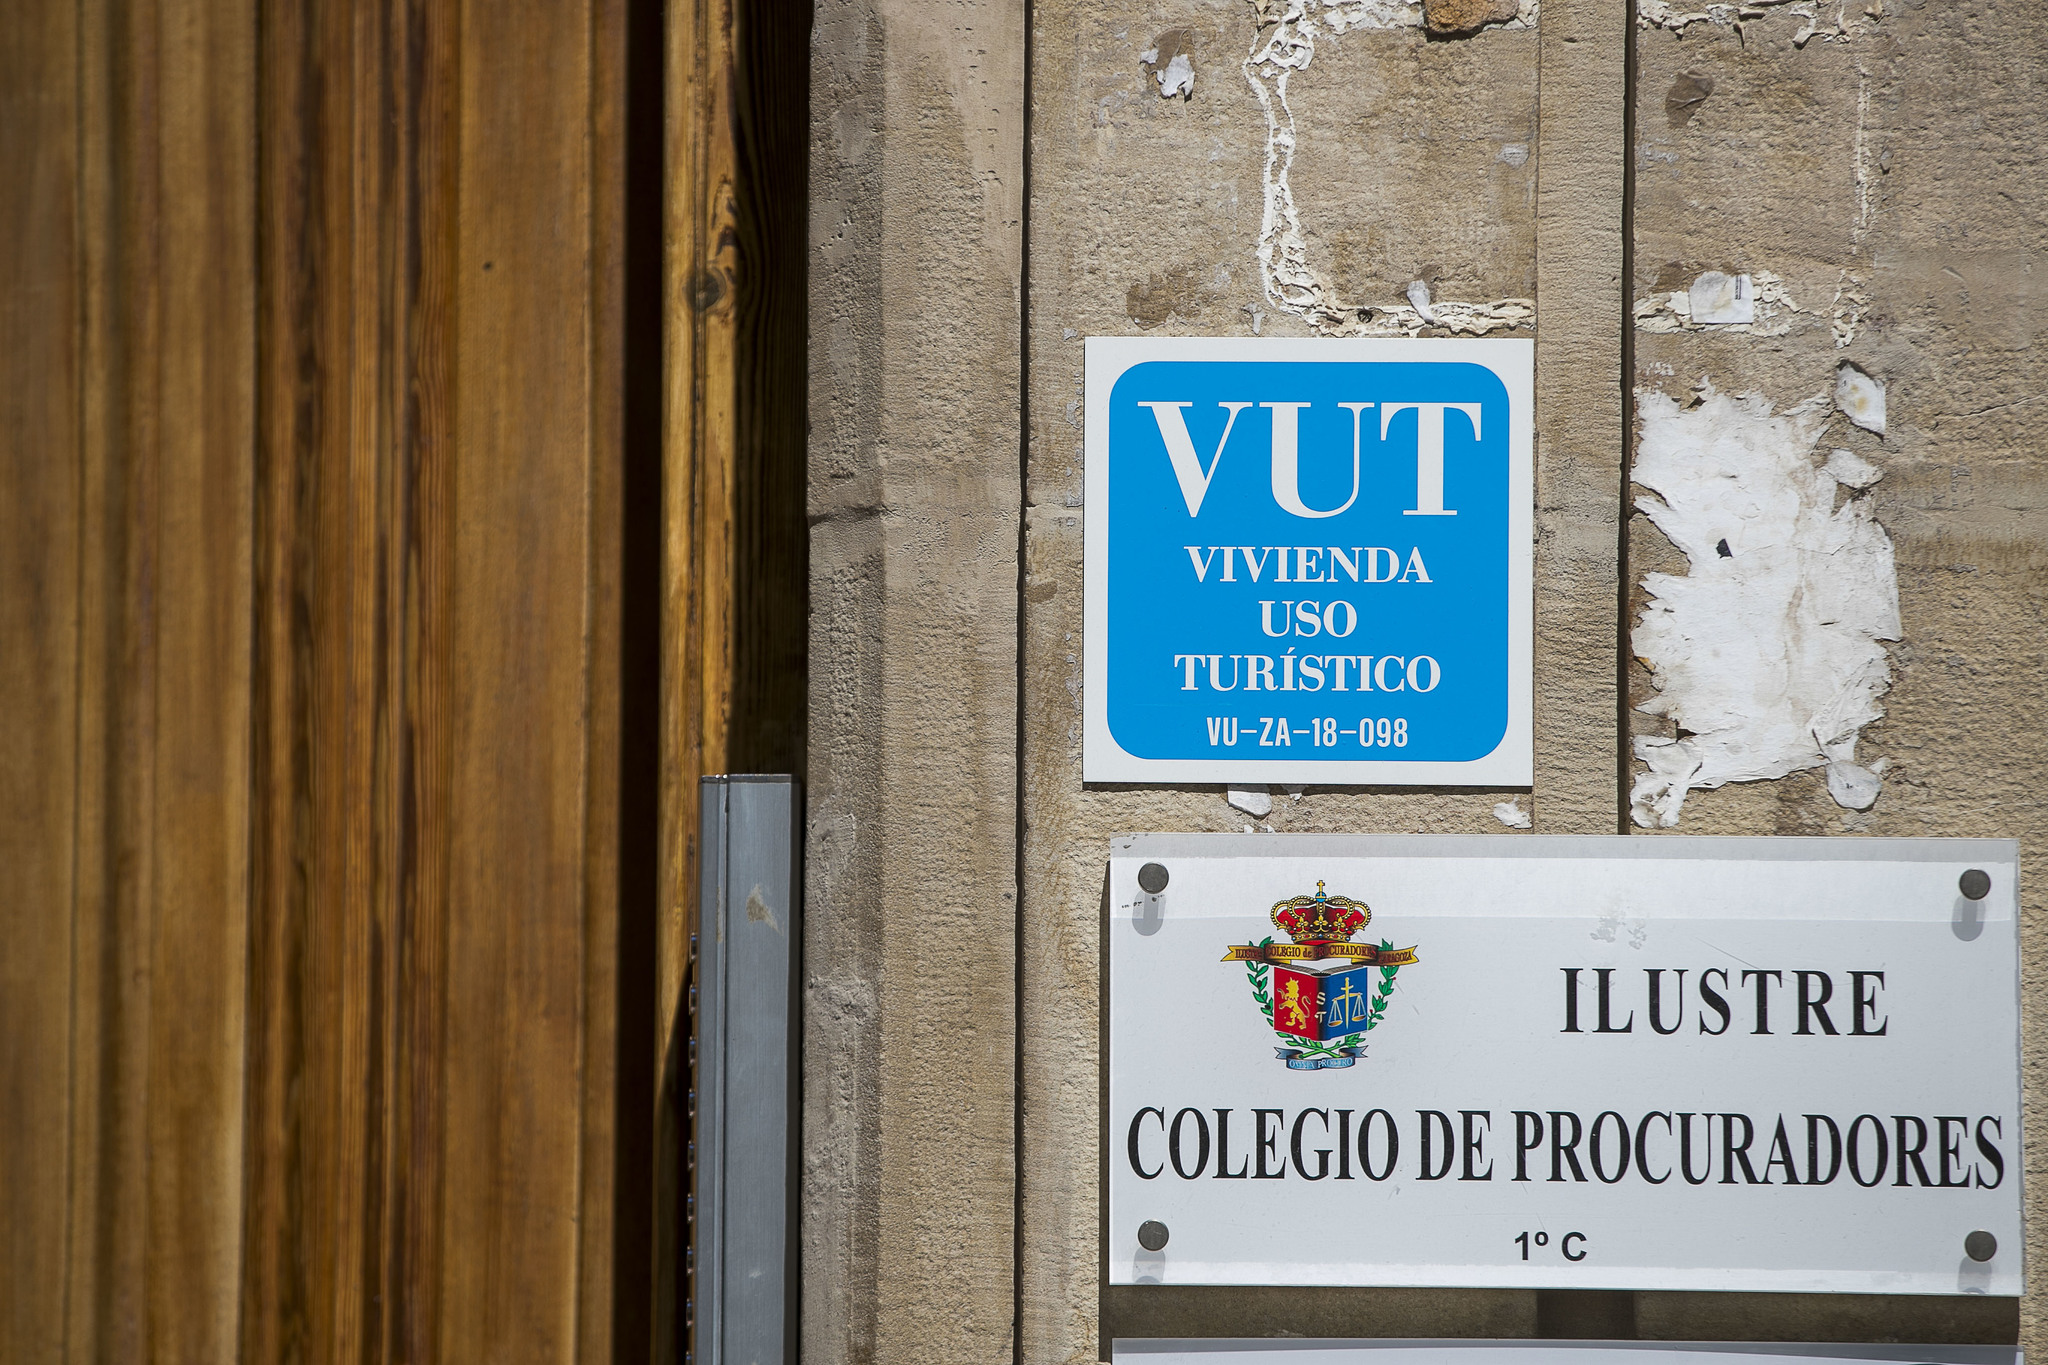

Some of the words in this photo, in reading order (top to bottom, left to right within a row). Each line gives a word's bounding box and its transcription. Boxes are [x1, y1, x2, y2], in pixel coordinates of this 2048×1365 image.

[1137, 401, 1482, 519] VUT
[1183, 545, 1434, 583] VIVIENDA
[1258, 599, 1358, 638] USO
[1174, 646, 1441, 693] TURÍSTICO
[1206, 716, 1409, 748] VU-ZA-18-098
[1559, 967, 1888, 1037] ILUSTRE
[1127, 1106, 1399, 1182] COLEGIO
[1415, 1109, 1494, 1182] DE
[1510, 1110, 2004, 1190] PROCURADORES
[1561, 1231, 1587, 1262] C
